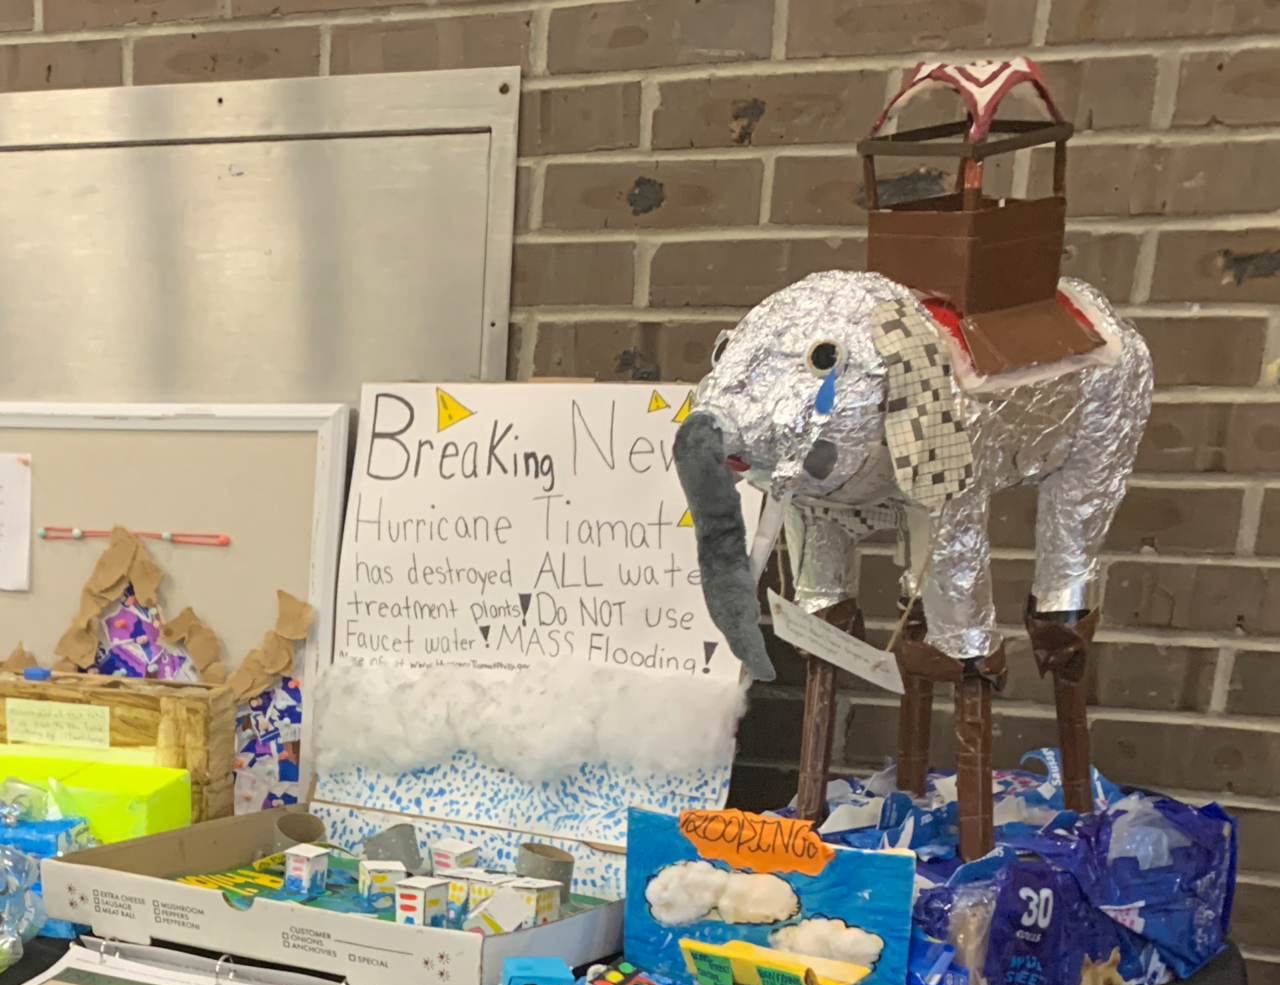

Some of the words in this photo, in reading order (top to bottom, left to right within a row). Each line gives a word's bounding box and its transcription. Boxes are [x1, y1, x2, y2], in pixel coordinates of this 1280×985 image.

[571, 398, 677, 477] Ne
[355, 492, 513, 545] Hurricane
[532, 494, 673, 549] Tiamat
[355, 552, 394, 585] has
[407, 551, 513, 595] destroyed
[534, 550, 604, 590] ALL
[618, 552, 703, 589] wate
[346, 590, 459, 619] treatment
[535, 590, 568, 627] Do
[578, 596, 626, 628] NOT
[643, 606, 695, 631] use
[345, 618, 415, 653] Faucet
[495, 624, 575, 658] MASS
[100, 890, 120, 901] EXTRA
[120, 895, 146, 905] CHEESE
[101, 899, 132, 911] SAUSAGE
[102, 907, 120, 917] MEAT
[120, 910, 136, 920] BALL
[160, 901, 205, 916] MUSHROOM
[161, 910, 189, 921] PEPPERS
[1018, 886, 1055, 930] 30
[162, 918, 201, 931] PEPPERONI
[289, 926, 332, 940] CUSTOMER
[290, 934, 325, 947] ONIONS
[291, 942, 338, 958] ANCHOVIES
[357, 955, 389, 969] SPECIAL
